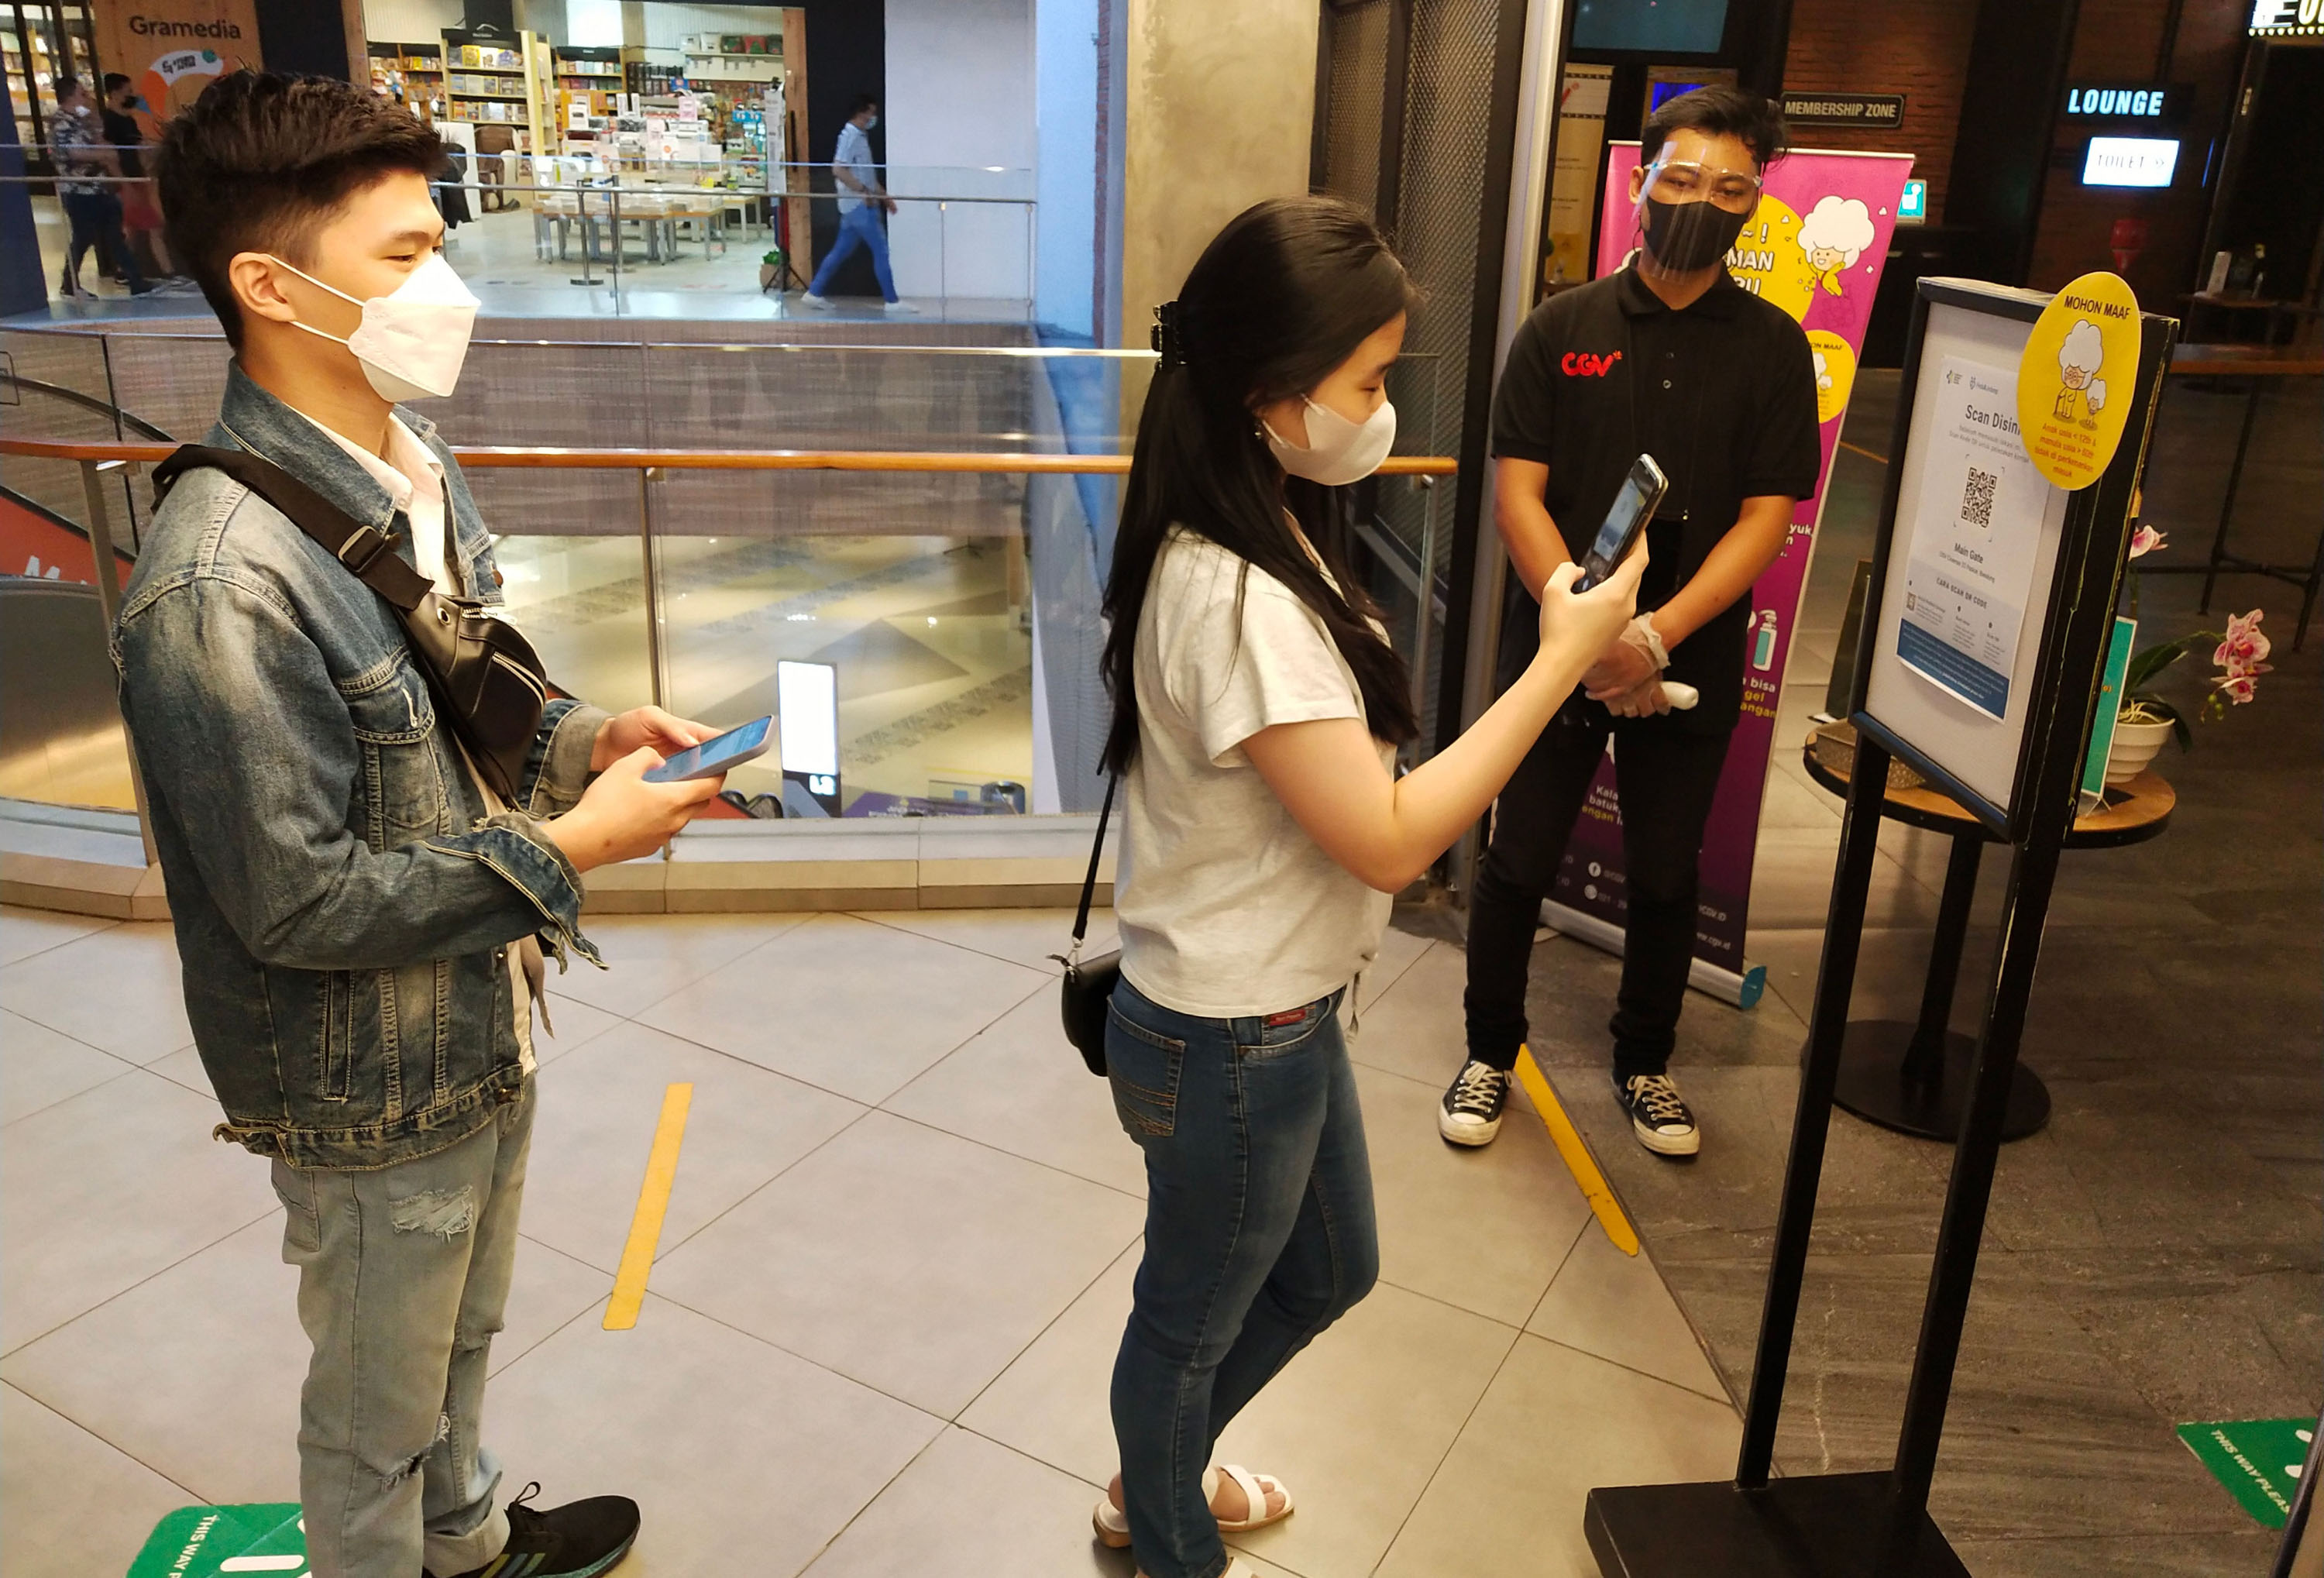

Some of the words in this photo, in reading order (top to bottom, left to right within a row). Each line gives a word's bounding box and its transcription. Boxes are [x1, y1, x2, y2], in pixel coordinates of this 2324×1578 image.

[129, 15, 242, 39] Gramedia
[1785, 101, 1863, 117] MEMBERSHIP
[1865, 103, 1896, 118] ZONE
[2068, 88, 2164, 116] LOUNGE
[2064, 295, 2102, 314] MOHON
[2103, 303, 2131, 320] MAAF
[1561, 351, 1614, 377] CGV
[1965, 404, 1990, 425] Scan
[1954, 542, 1968, 557] Main
[1969, 549, 1984, 564] Gate
[1751, 677, 1776, 693] bisa
[2211, 1429, 2239, 1453] THIS
[2233, 1454, 2261, 1477] WAY
[191, 1514, 221, 1542] THIS
[174, 1543, 201, 1571] WAY
